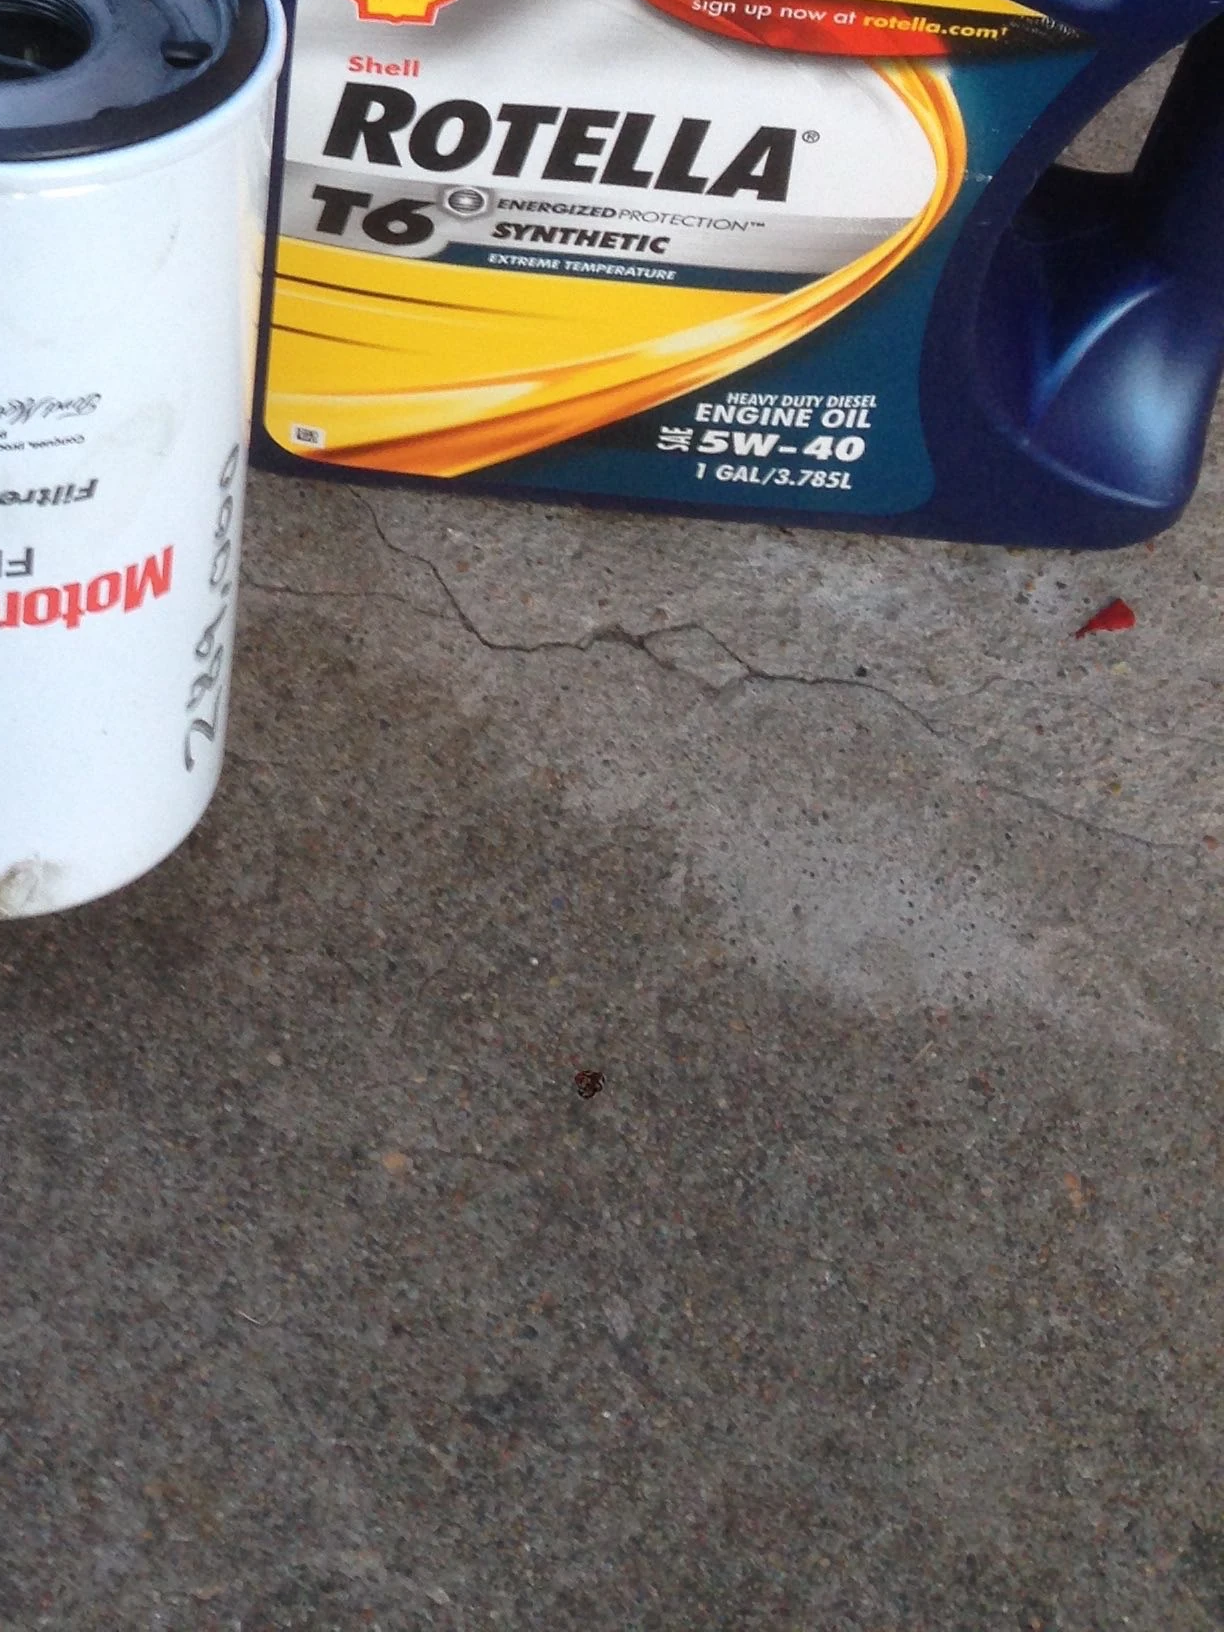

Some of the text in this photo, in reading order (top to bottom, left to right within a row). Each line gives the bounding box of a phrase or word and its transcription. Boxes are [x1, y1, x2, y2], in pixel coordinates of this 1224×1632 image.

[744, 2, 772, 20] up
[780, 7, 827, 23] now
[833, 10, 857, 27] at
[347, 55, 421, 78] Shell
[312, 184, 437, 246] T6
[492, 221, 672, 255] SYNTHETIC
[486, 253, 677, 282] EXTREME TEMPERATURE
[726, 392, 877, 409] HEAVY DUTY DIESEL
[694, 402, 872, 429] ENGINE OIL
[656, 425, 694, 453] SAE
[696, 429, 867, 463] 5W-40
[694, 462, 853, 490] 1 GAL/3.785L
